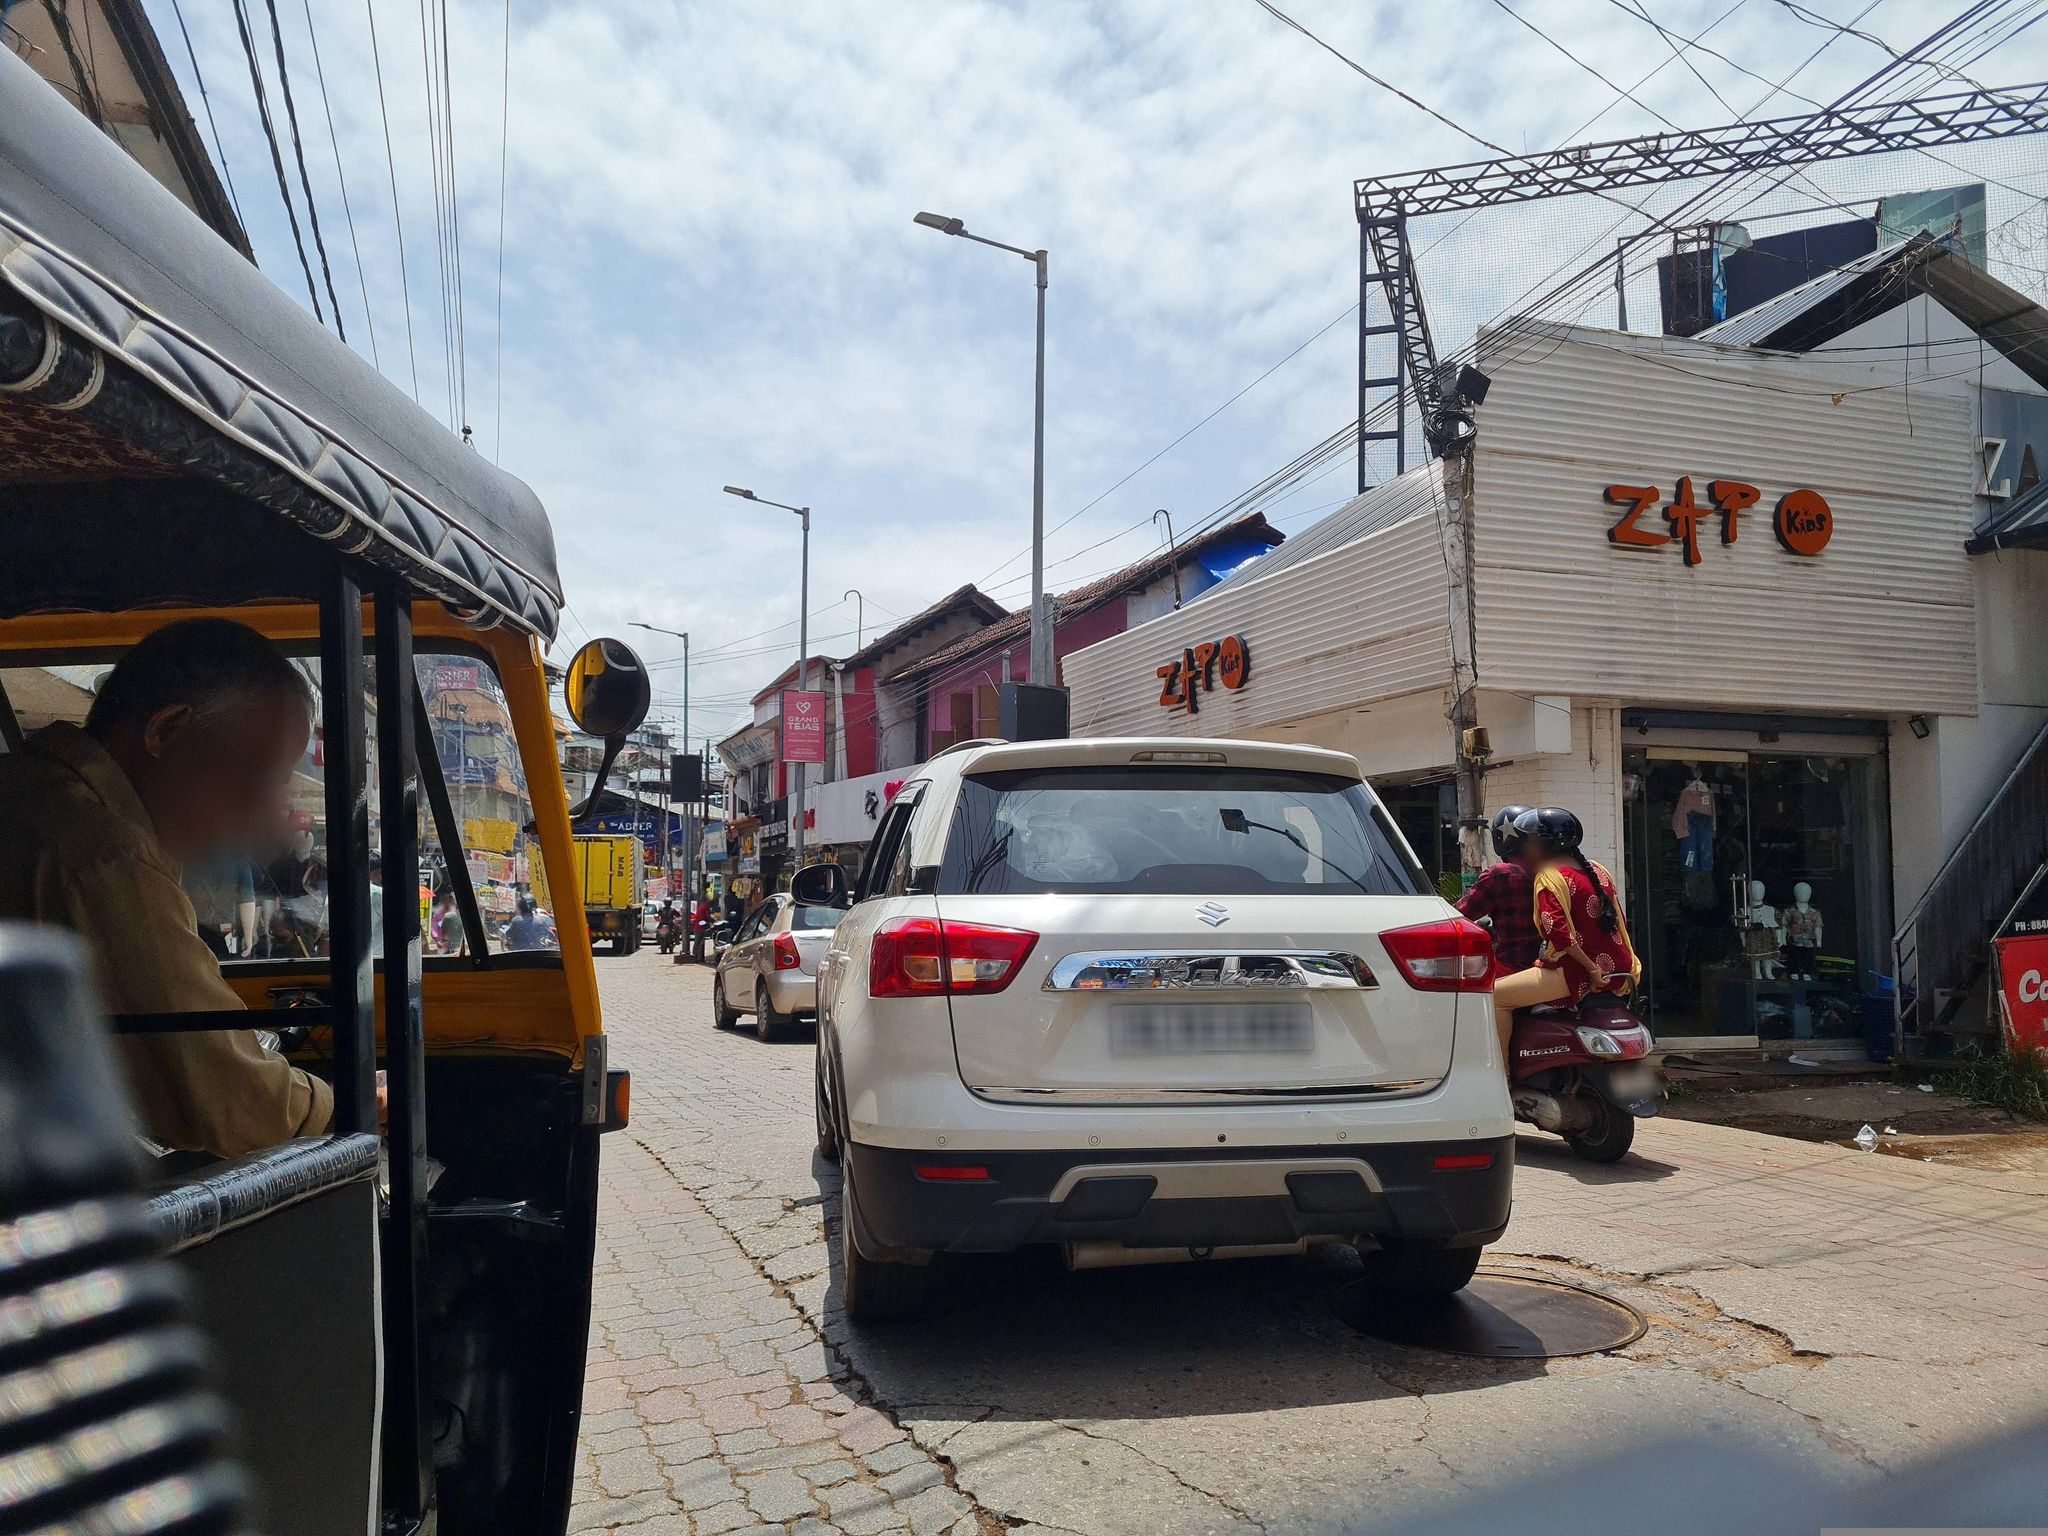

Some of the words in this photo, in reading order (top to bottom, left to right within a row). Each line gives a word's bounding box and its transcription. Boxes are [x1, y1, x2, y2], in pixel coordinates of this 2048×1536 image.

[787, 722, 820, 731] TEJAS
[1131, 959, 1188, 968] VITARA
[1127, 967, 1309, 989] BREZZA
